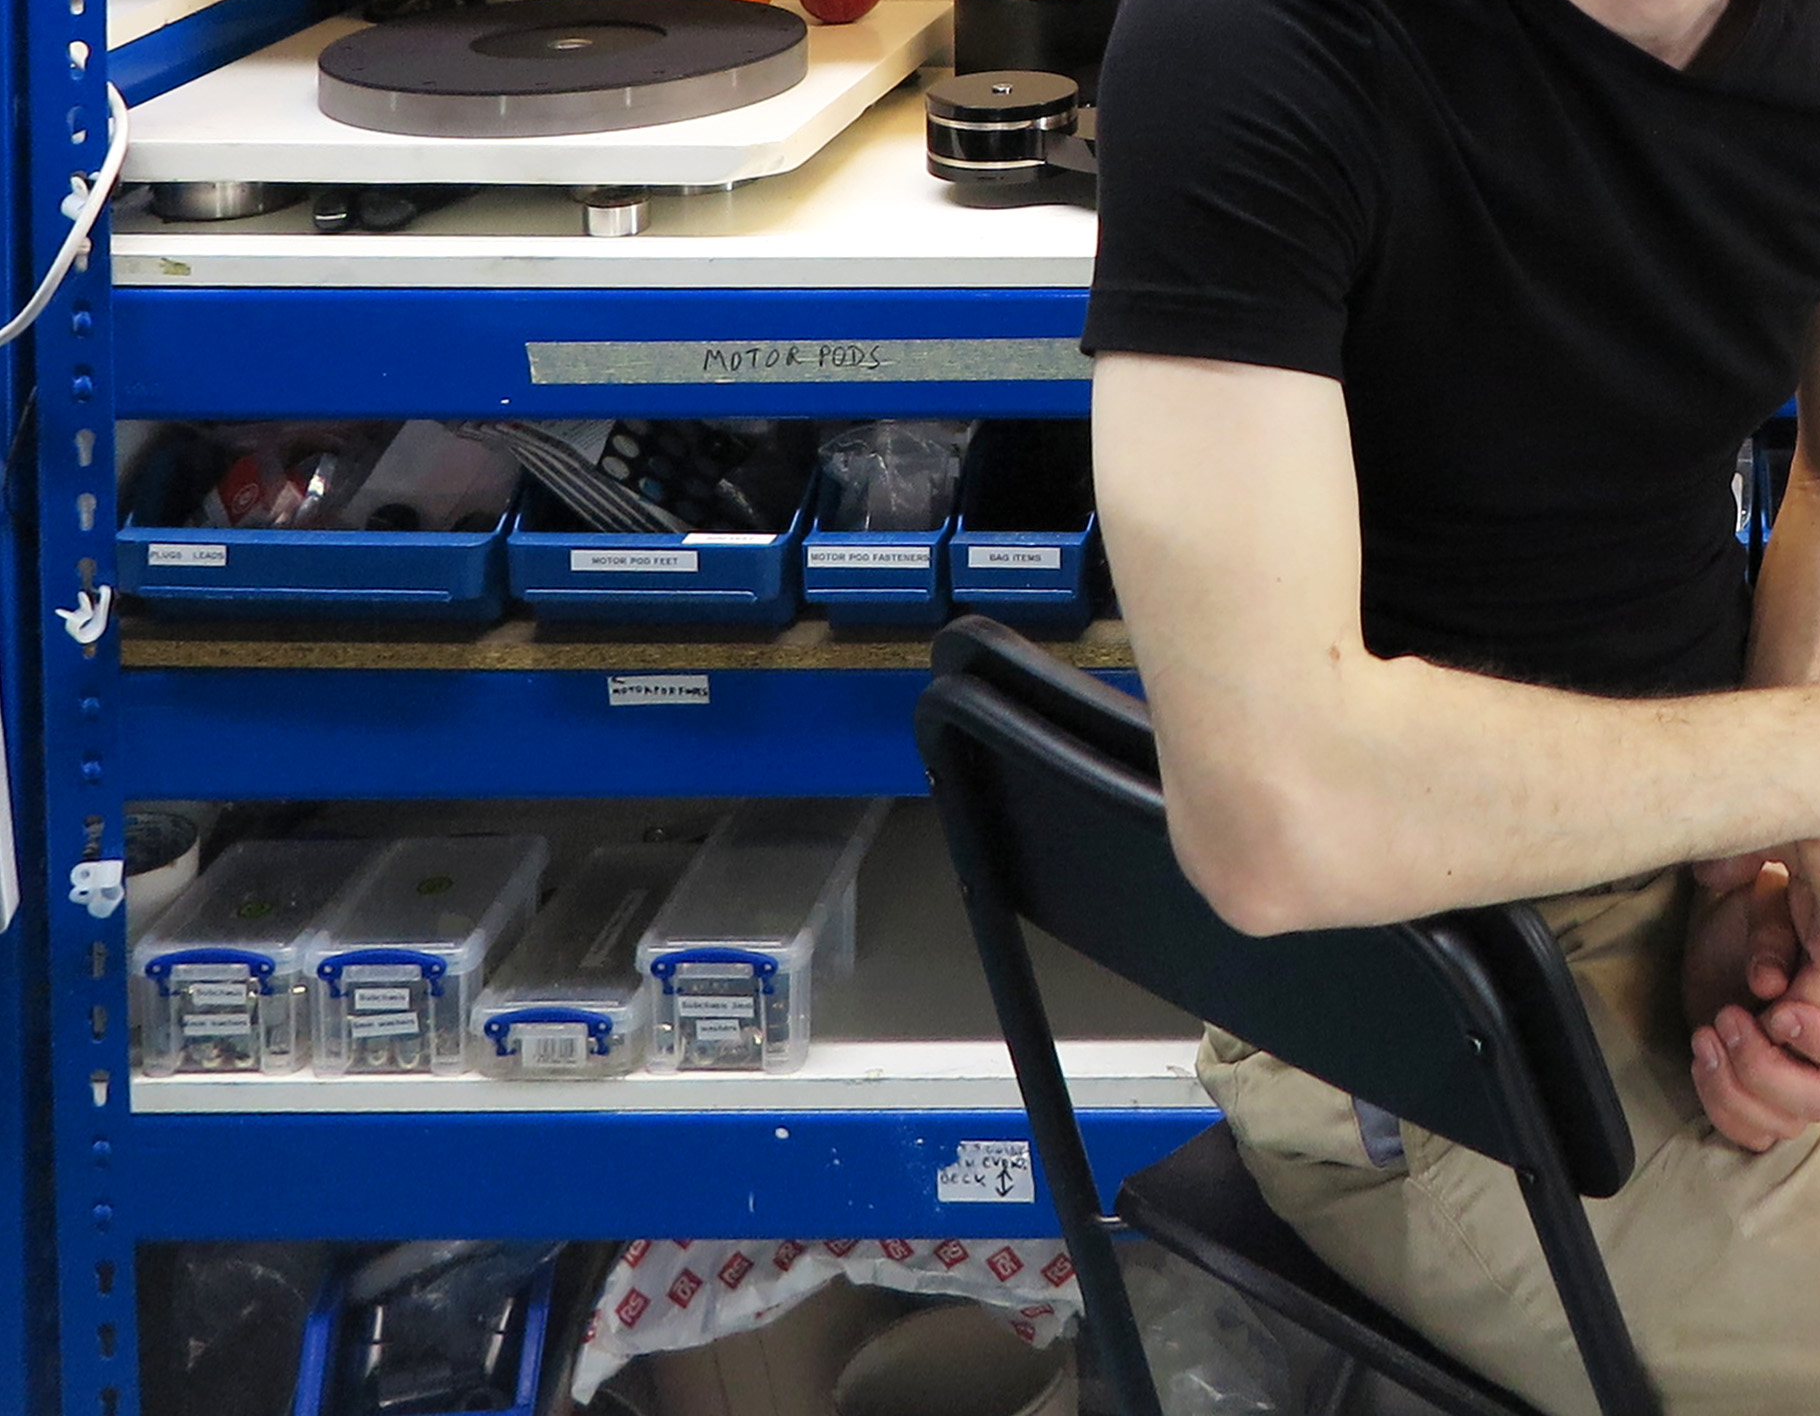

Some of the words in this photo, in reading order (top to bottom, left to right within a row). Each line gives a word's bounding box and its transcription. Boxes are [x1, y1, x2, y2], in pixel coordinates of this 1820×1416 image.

[703, 345, 801, 372] MOTOR
[818, 344, 881, 370] PODS
[591, 556, 627, 566] MOTOR
[653, 557, 679, 566] FEET
[810, 552, 846, 562] MOTOR
[872, 553, 930, 563] FASTENERS
[989, 553, 1010, 563] BAG
[1012, 553, 1042, 563] ITEMS
